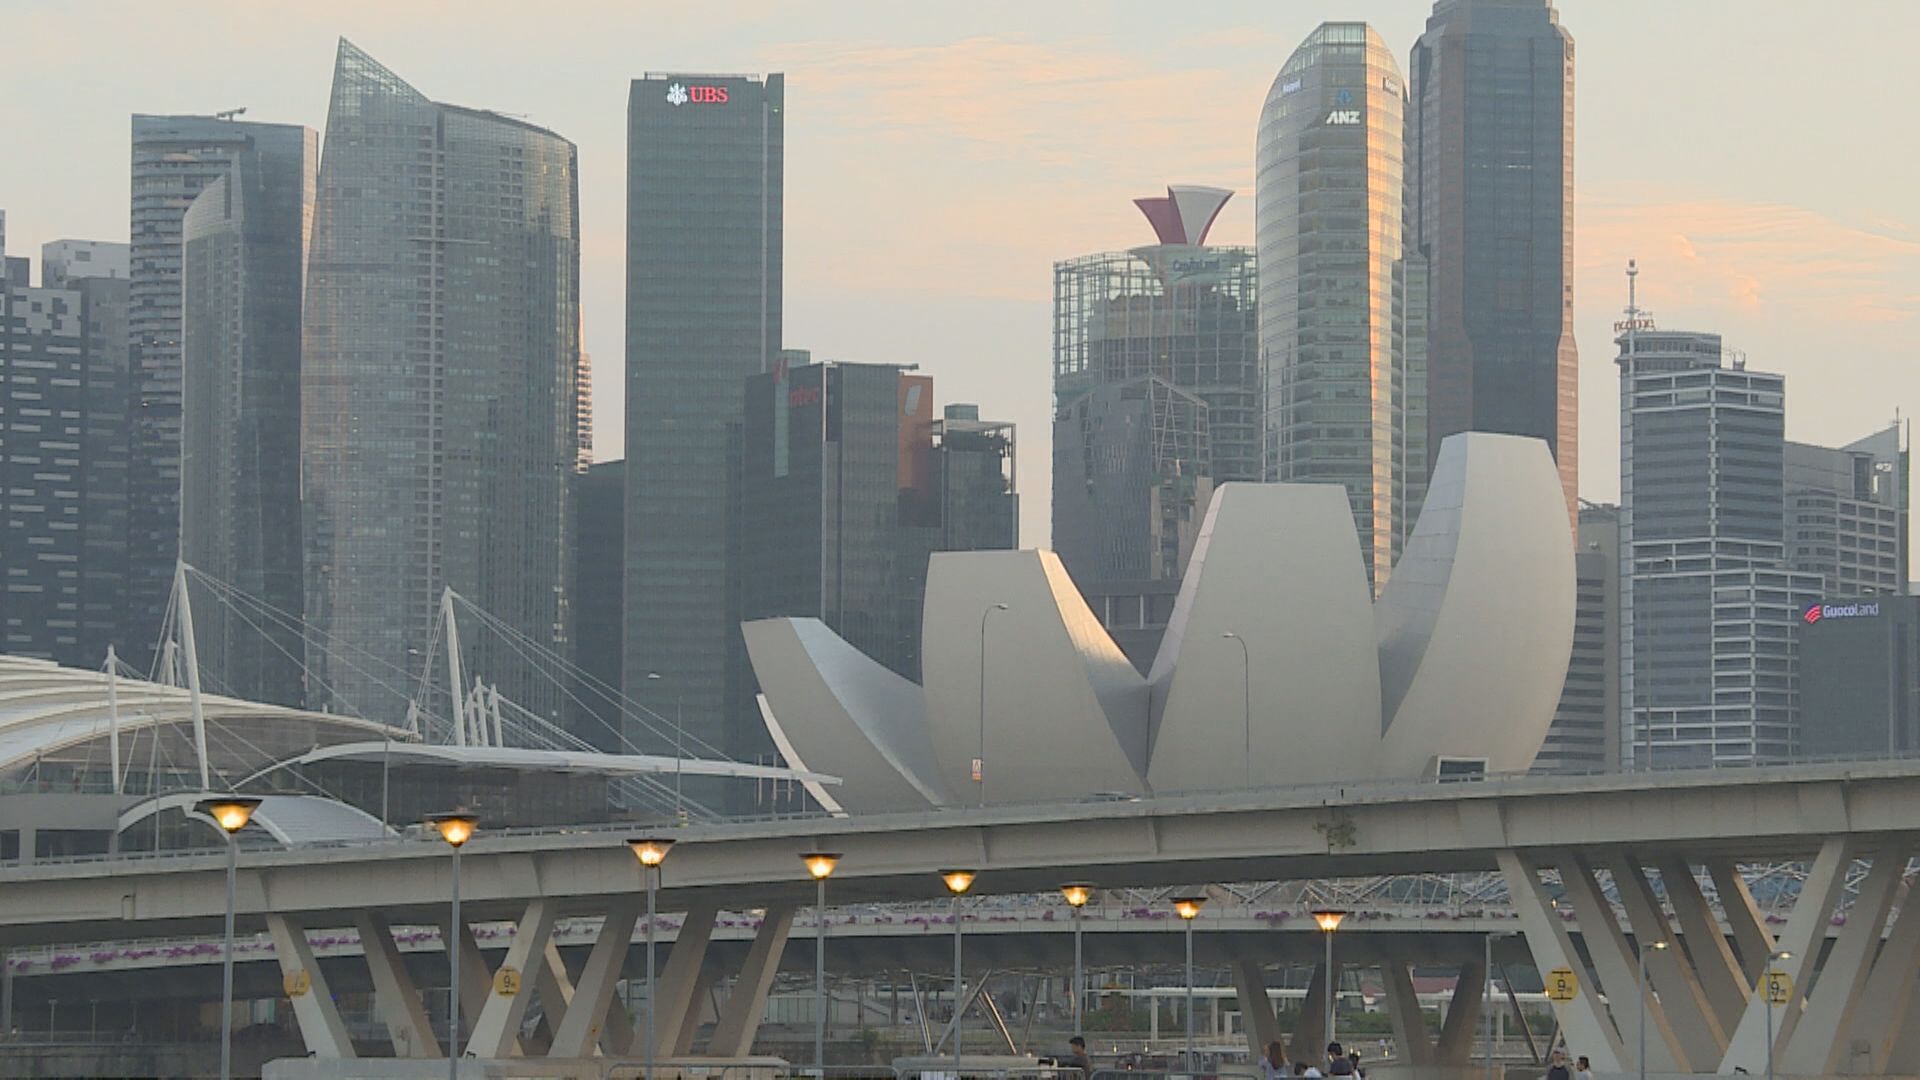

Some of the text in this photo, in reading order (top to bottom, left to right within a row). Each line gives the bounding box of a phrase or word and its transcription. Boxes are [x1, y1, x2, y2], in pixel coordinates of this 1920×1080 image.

[689, 86, 728, 102] UBS
[1326, 111, 1360, 124] ANZ
[1823, 603, 1879, 618] GuocoLand
